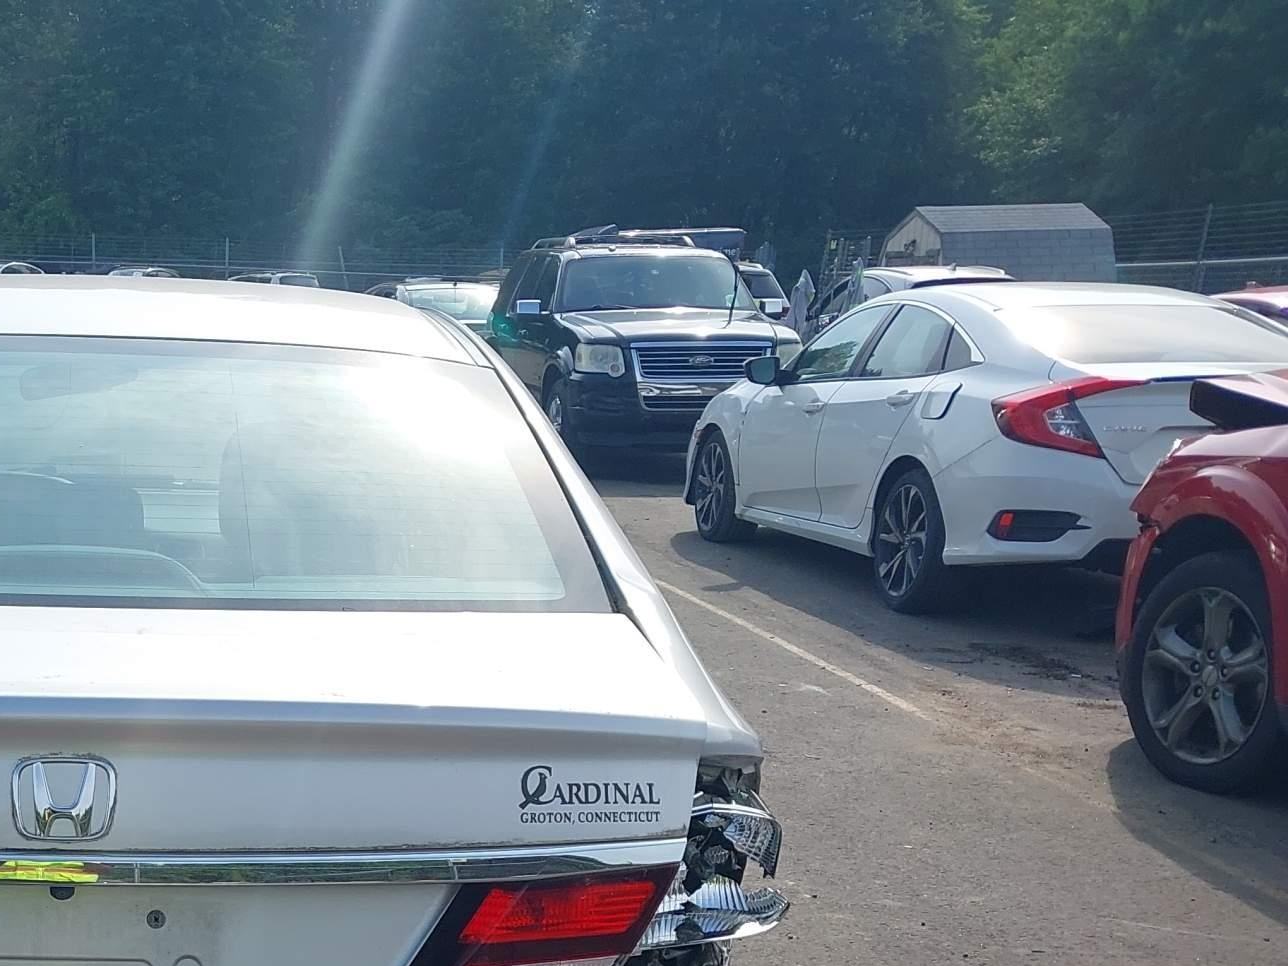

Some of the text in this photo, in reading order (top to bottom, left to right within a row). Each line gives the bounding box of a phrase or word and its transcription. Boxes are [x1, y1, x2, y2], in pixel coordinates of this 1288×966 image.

[518, 765, 661, 810] CARDINAL
[520, 811, 661, 825] GROTON, CONNECTICUT
